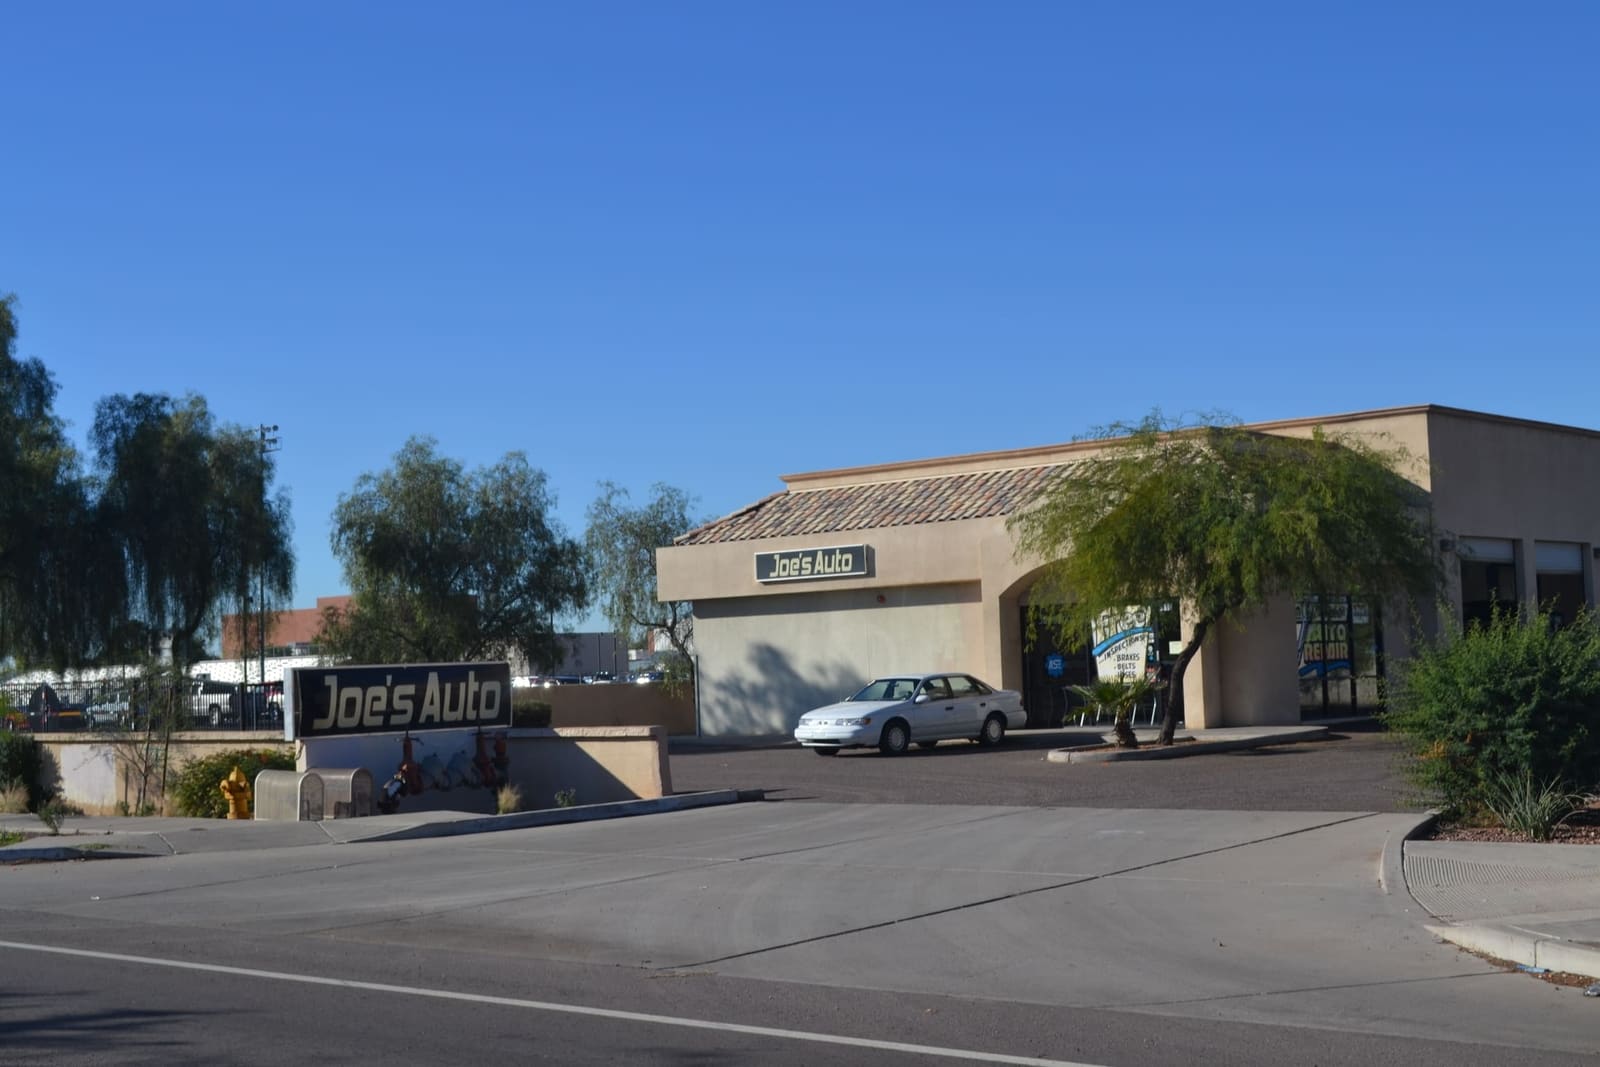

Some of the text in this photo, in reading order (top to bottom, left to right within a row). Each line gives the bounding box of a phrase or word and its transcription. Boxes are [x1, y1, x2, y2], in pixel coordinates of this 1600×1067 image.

[769, 548, 852, 578] Joe's Auto
[1117, 653, 1140, 663] BRAKES
[1303, 642, 1348, 661] REAIR
[313, 670, 501, 730] Joe's Auto
